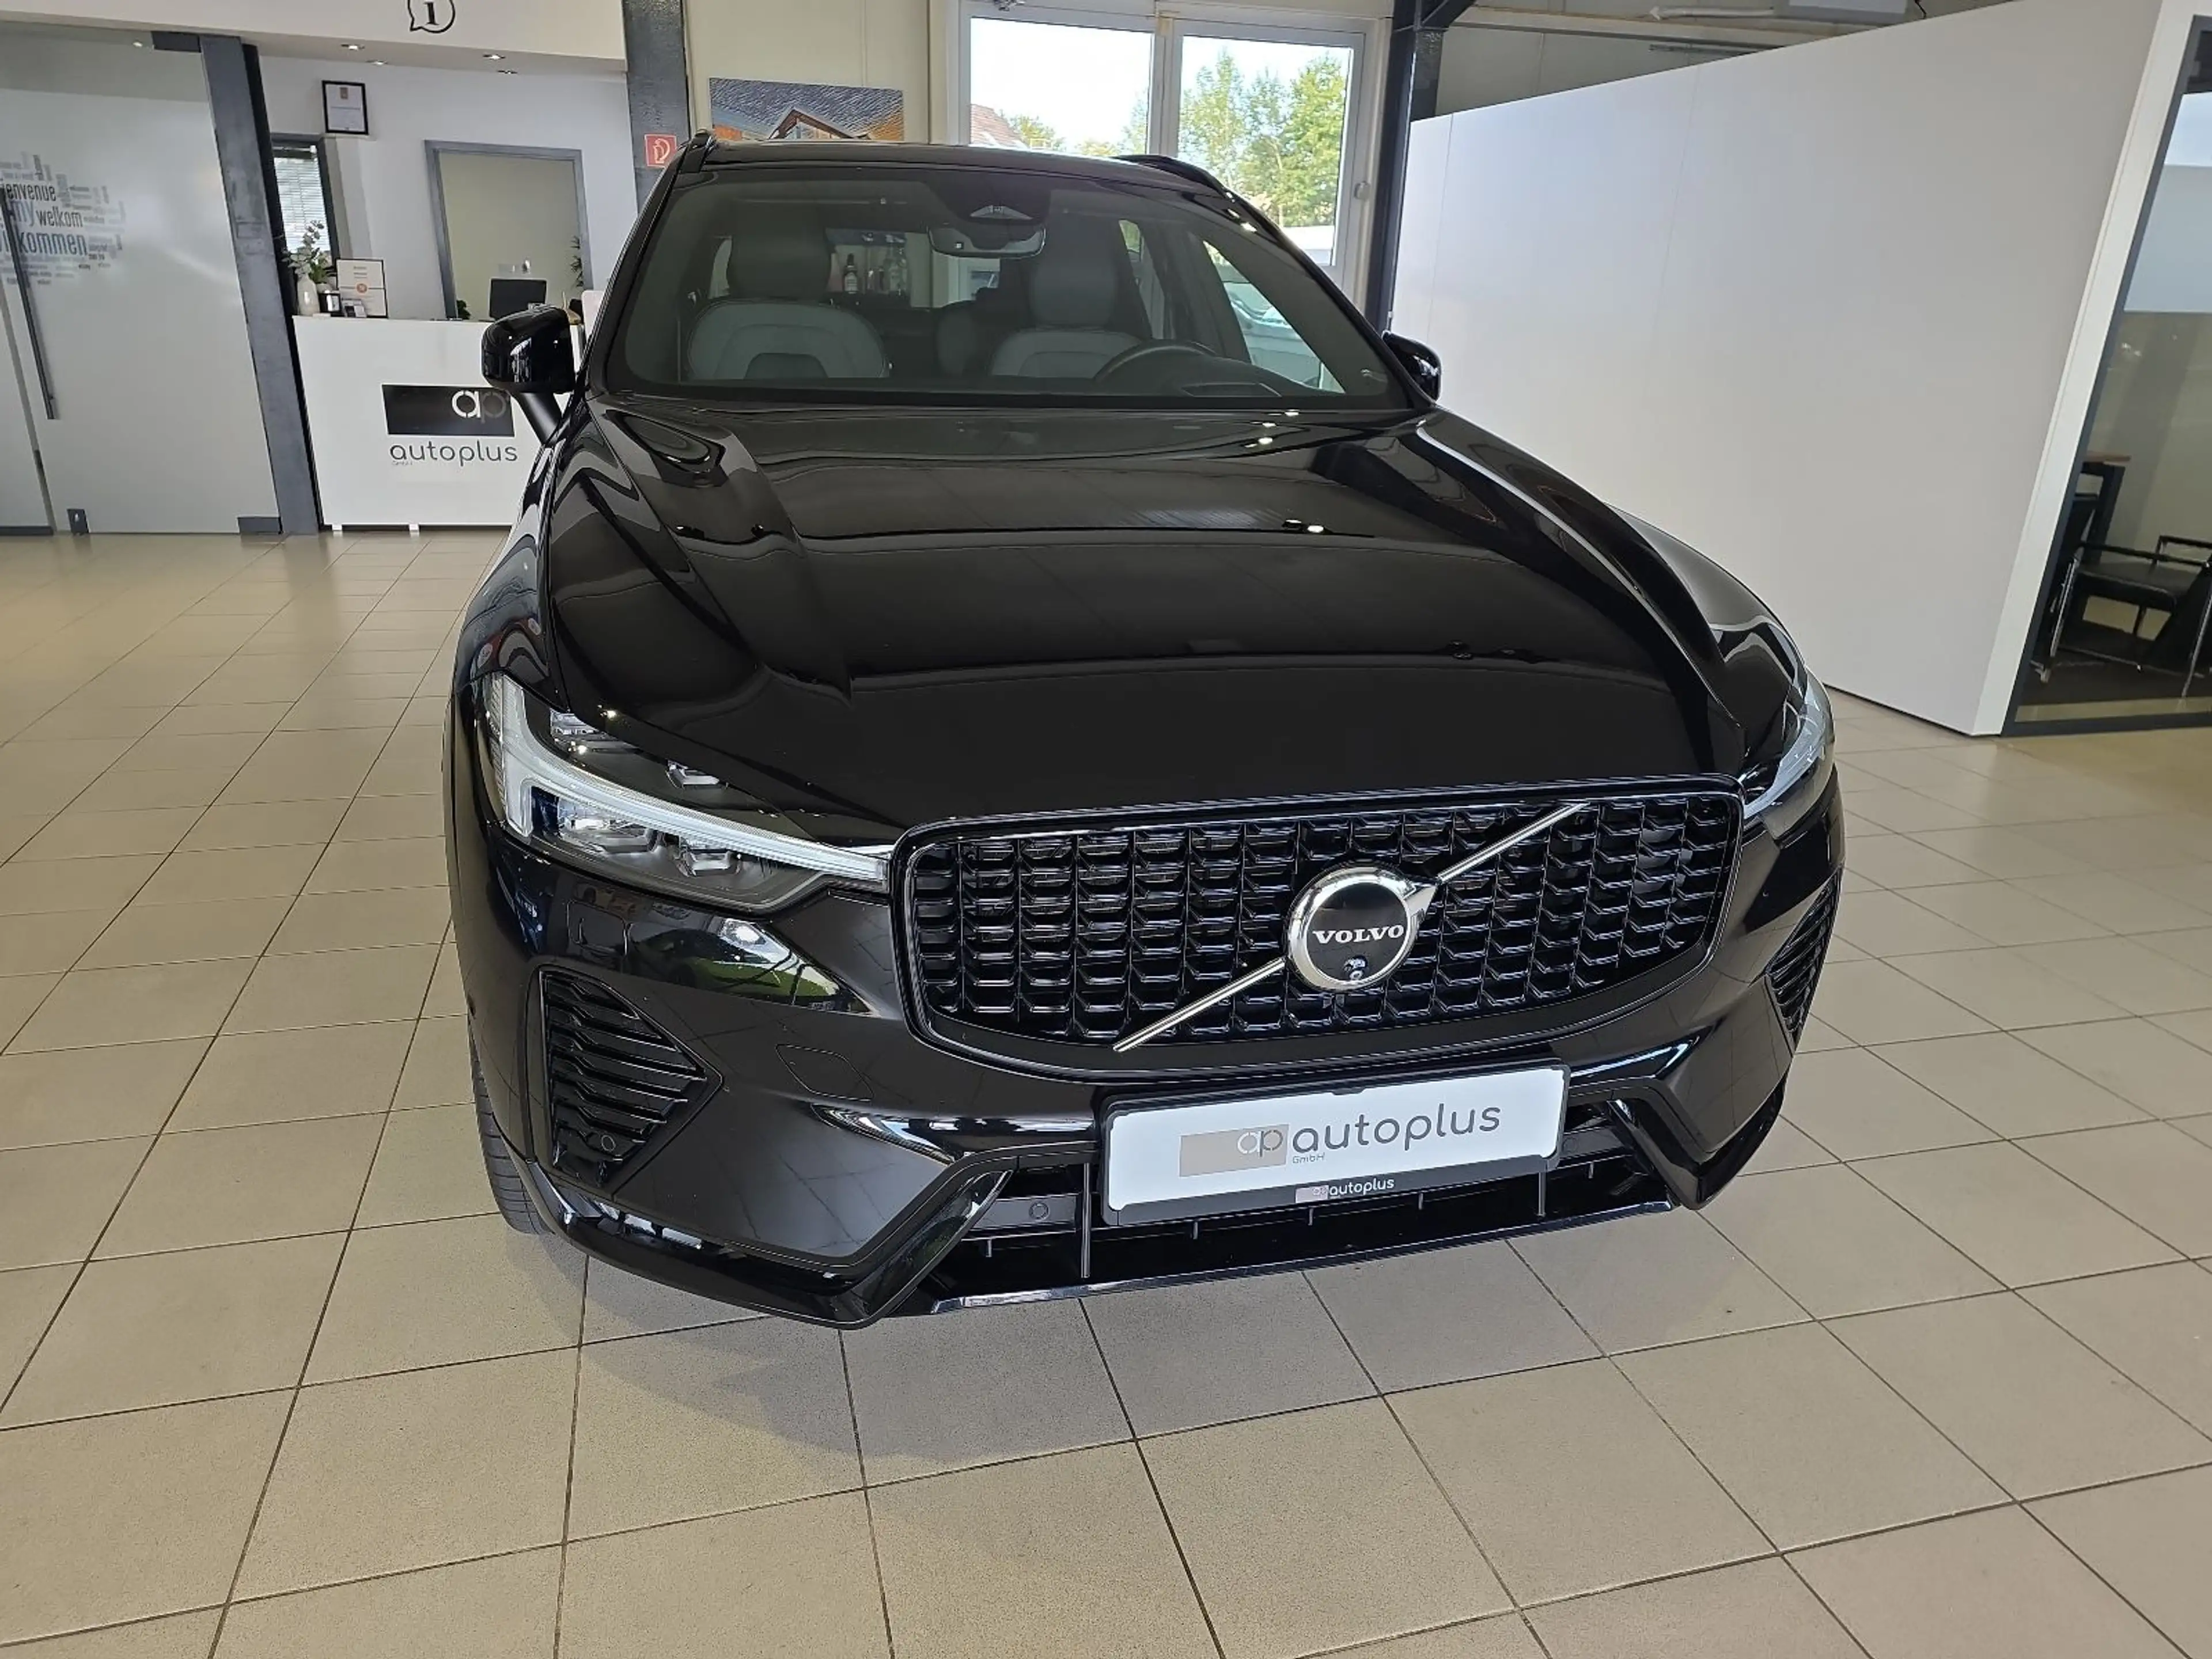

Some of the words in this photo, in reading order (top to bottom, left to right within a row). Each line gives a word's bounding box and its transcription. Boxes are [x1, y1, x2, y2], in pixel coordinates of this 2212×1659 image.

[36, 206, 84, 228] welkom
[389, 440, 518, 467] autoplus
[1312, 925, 1404, 944] VOLVO
[1292, 1103, 1501, 1153] autoplus
[1292, 1152, 1325, 1164] GmbH
[1330, 1177, 1395, 1196] autoplus
